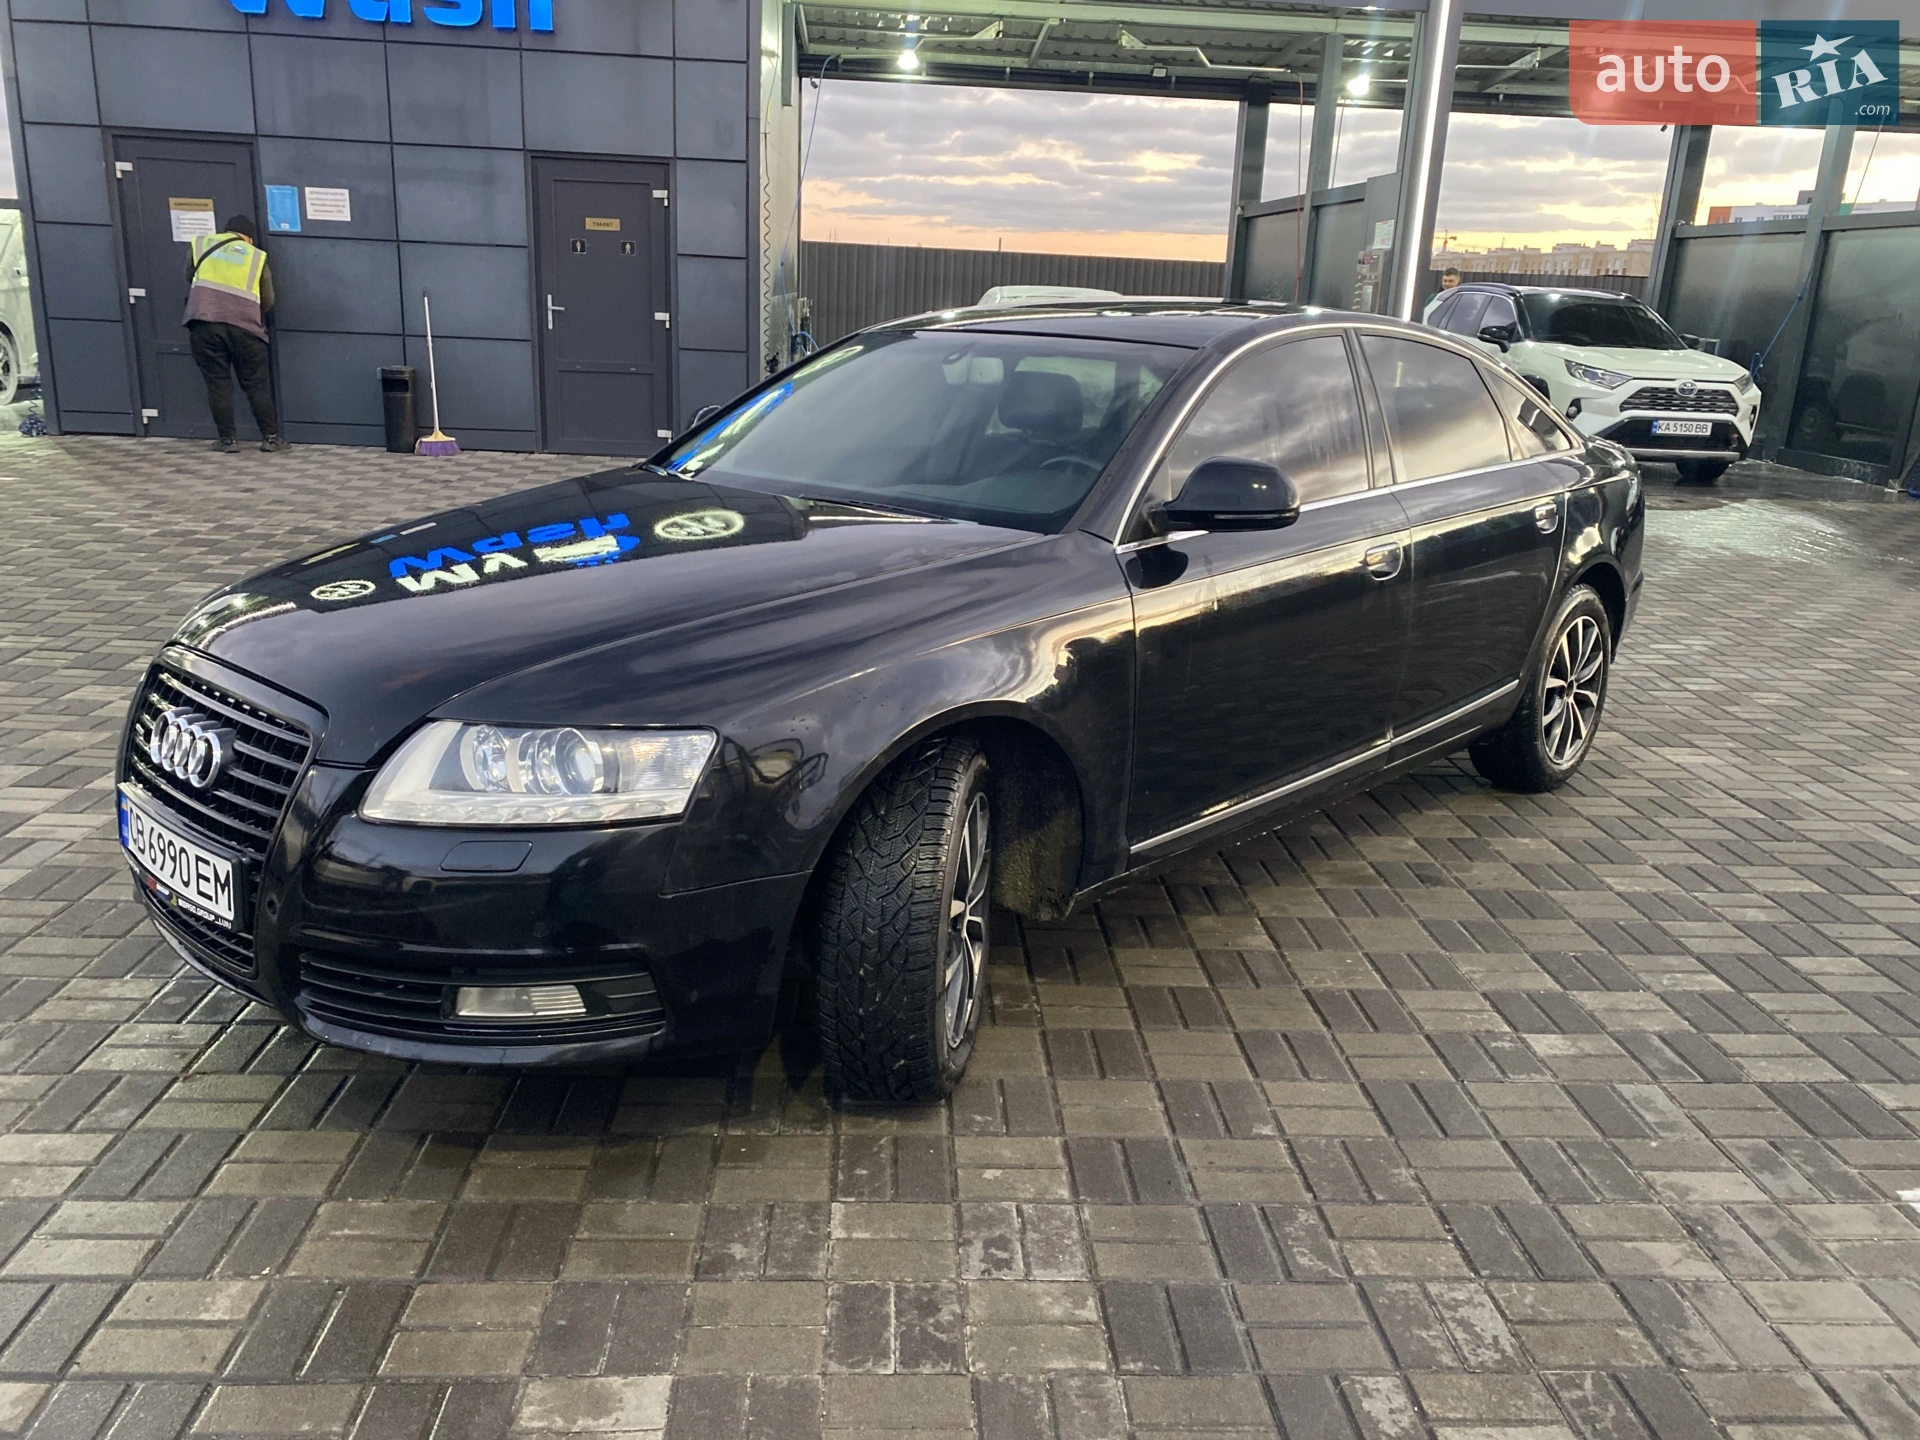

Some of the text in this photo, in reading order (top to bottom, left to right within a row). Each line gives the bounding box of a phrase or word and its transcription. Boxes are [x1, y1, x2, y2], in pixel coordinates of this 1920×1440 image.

[1657, 422, 1708, 434] KA 5150 BB
[148, 826, 190, 888] 6990
[194, 853, 232, 912] EM
